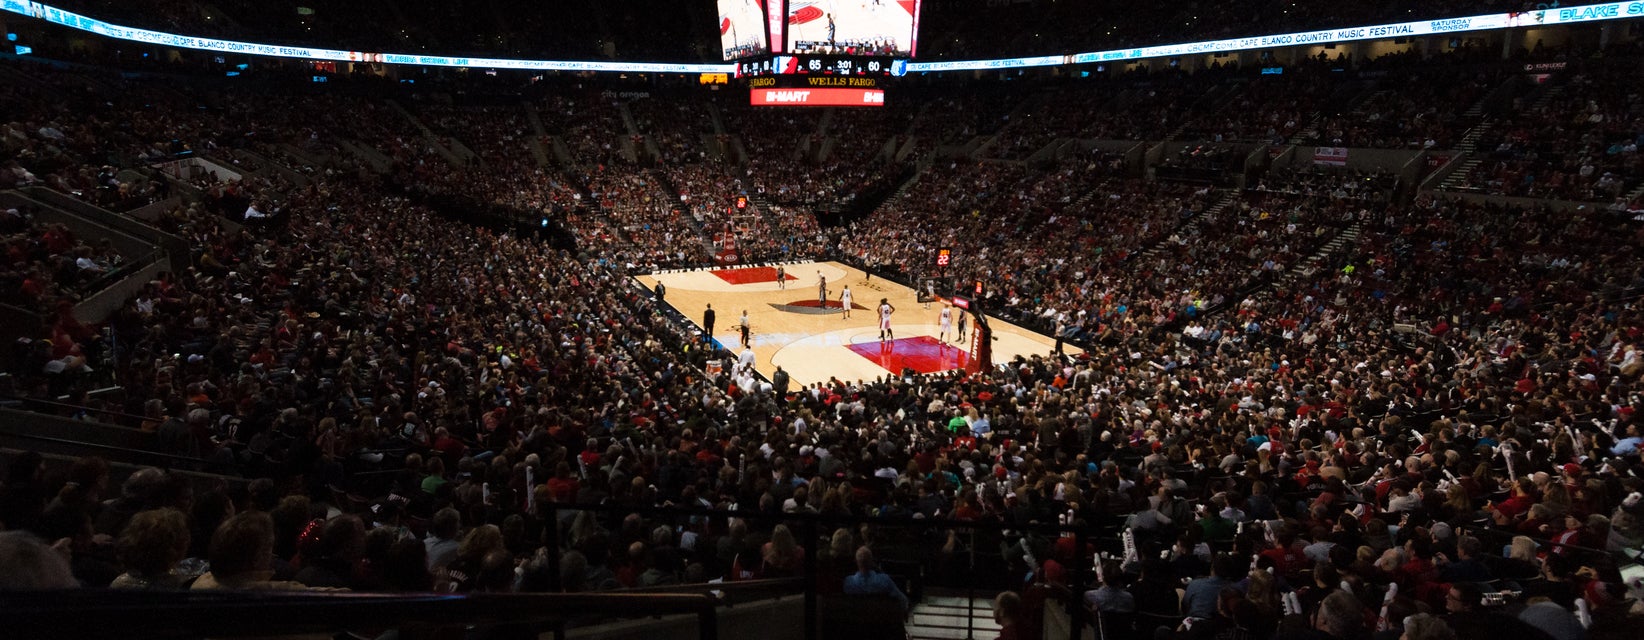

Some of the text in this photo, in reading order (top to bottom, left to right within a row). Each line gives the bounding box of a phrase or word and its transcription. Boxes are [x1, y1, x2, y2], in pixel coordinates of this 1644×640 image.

[1559, 2, 1644, 22] BLAKE S
[1431, 18, 1472, 27] SATURDAY
[1432, 24, 1470, 32] SPONSOR
[1240, 38, 1259, 48] CAPE
[1262, 35, 1293, 46] BLANCO
[1295, 32, 1334, 43] COUNTRY
[1337, 29, 1365, 39] MUSIC
[1369, 24, 1414, 36] FESTIVAL
[198, 39, 226, 50] BLANCO
[228, 42, 256, 52] COUNTRY
[258, 45, 276, 54] MUSIC
[280, 48, 312, 57] FESTIVAL
[809, 59, 822, 71] 65
[837, 60, 852, 69] 3:01
[868, 61, 880, 72] 60
[808, 77, 876, 87] WELLS FARGO
[766, 90, 811, 102] BI-MART
[937, 255, 949, 265] 22
